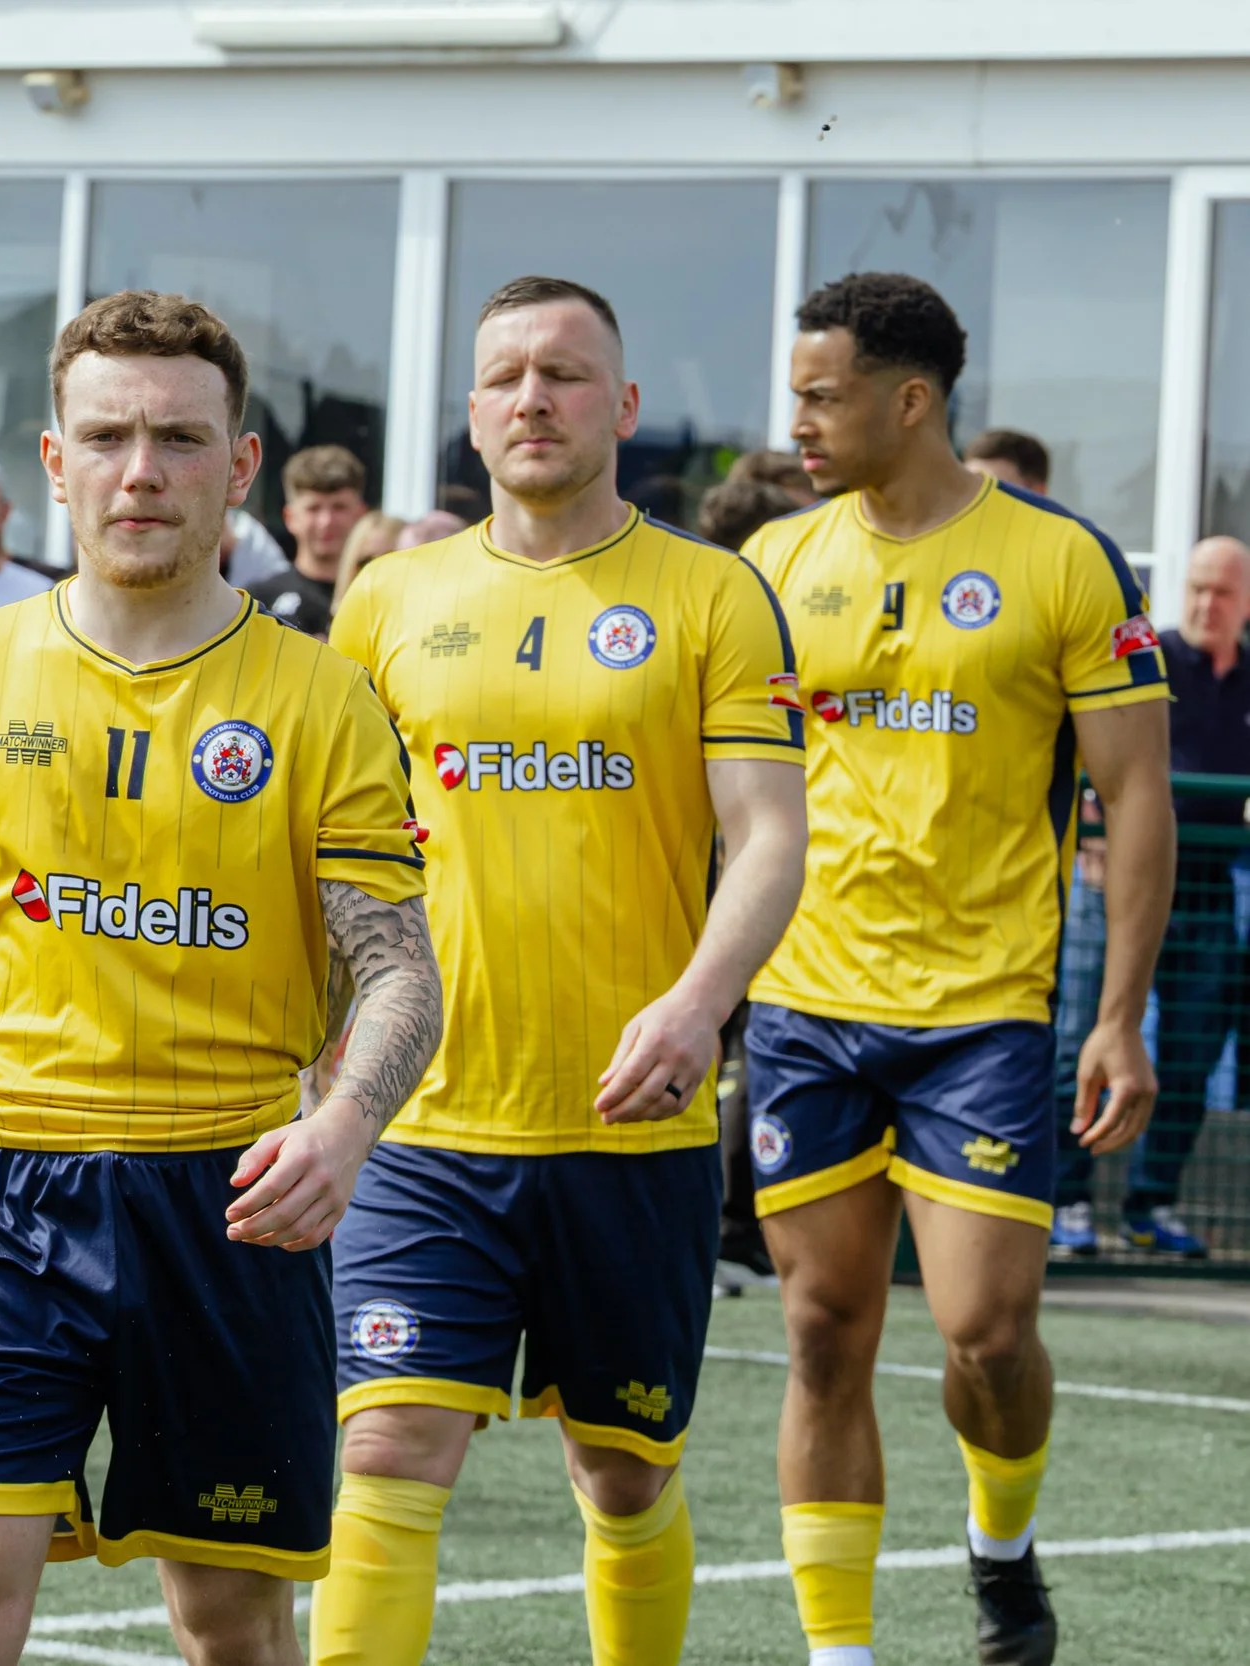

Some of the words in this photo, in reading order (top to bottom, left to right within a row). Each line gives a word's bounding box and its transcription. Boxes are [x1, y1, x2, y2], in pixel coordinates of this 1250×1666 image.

[882, 582, 905, 631] 9
[516, 616, 546, 671] 4
[845, 687, 978, 736] Fidelis
[199, 723, 249, 748] STALYBRIDGE
[248, 728, 269, 750] CELTIC
[105, 726, 151, 800] 11
[467, 740, 634, 790] Fidelis
[200, 780, 240, 801] FOOTBALL
[240, 784, 261, 799] CLUB
[47, 873, 248, 949] Fidelis
[200, 1495, 275, 1510] MATCHWINNER
